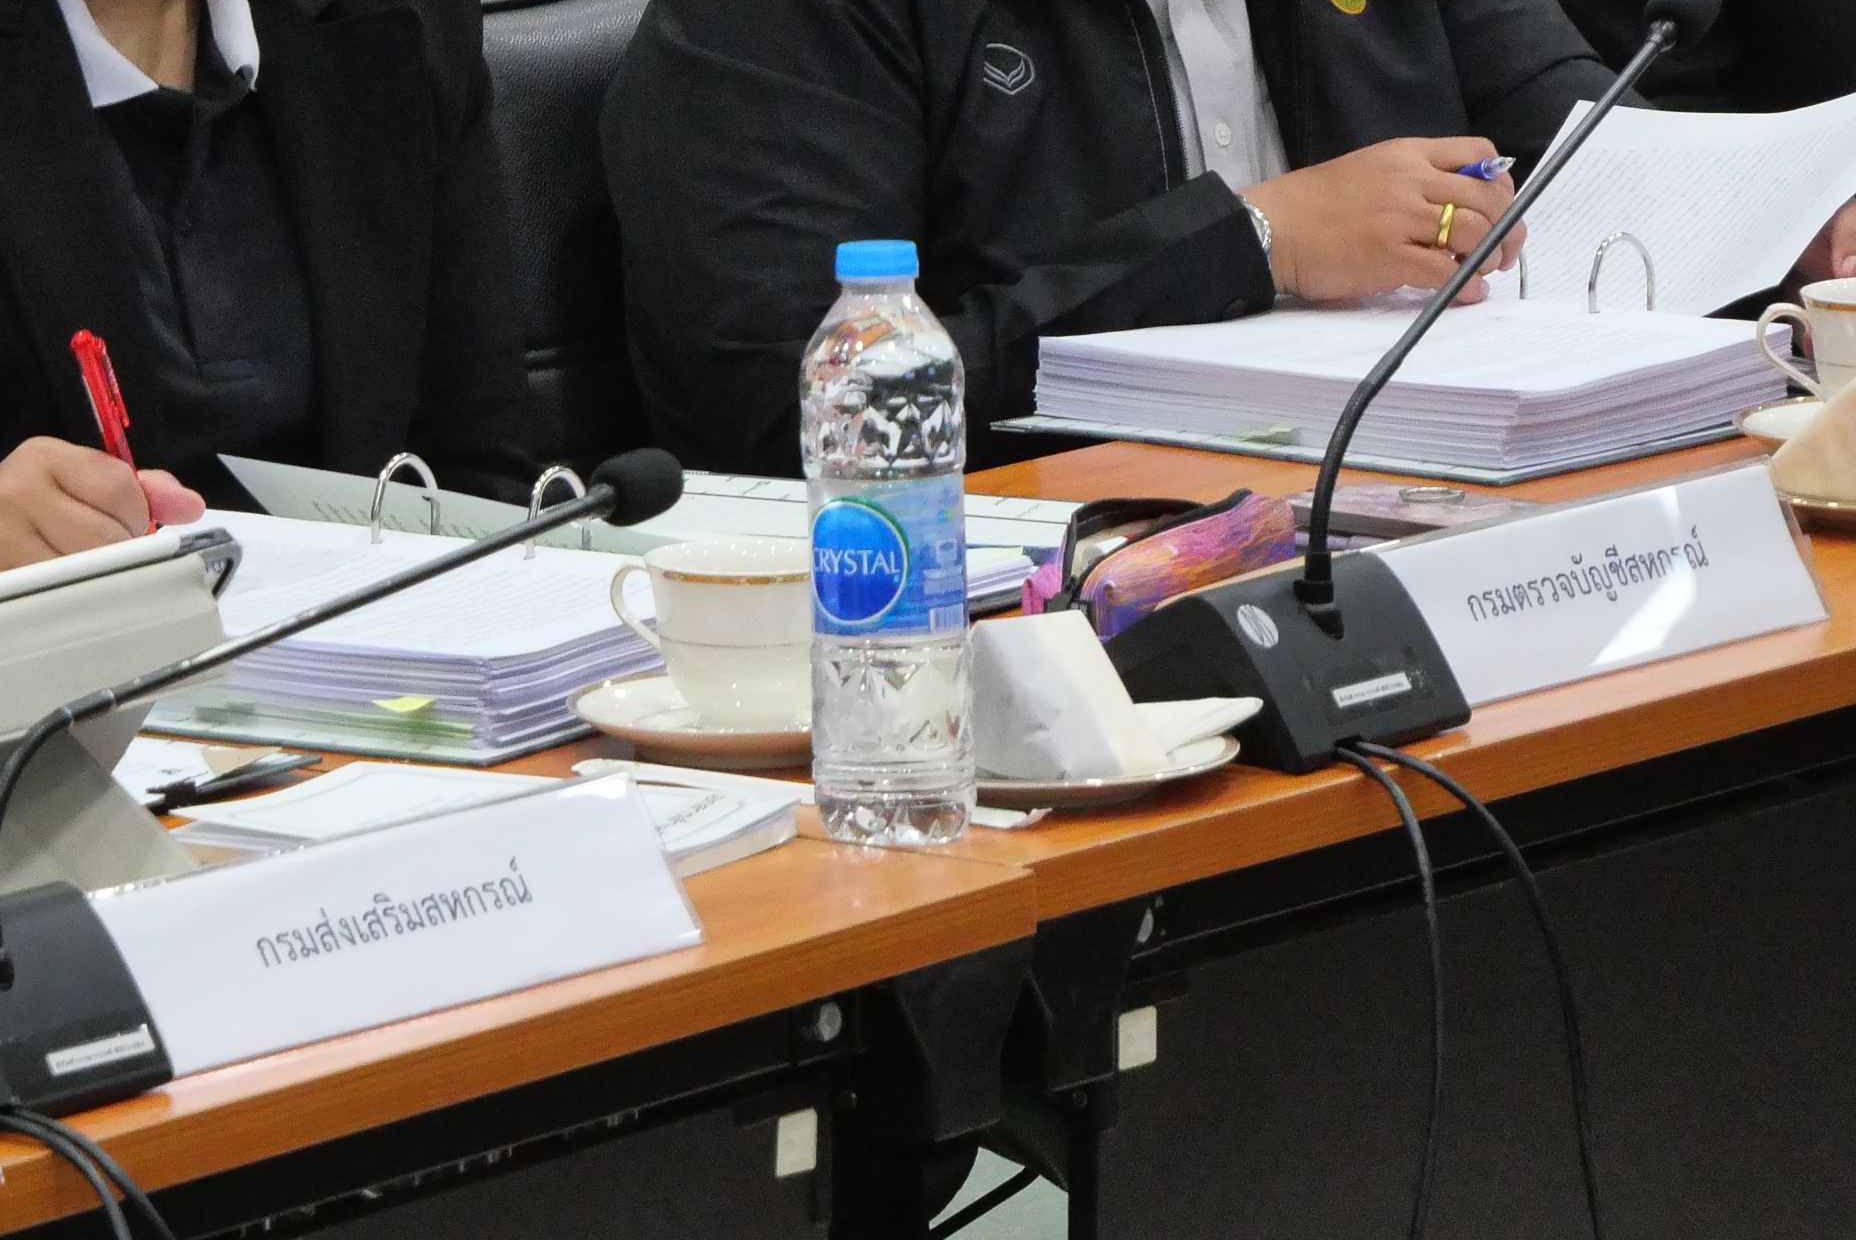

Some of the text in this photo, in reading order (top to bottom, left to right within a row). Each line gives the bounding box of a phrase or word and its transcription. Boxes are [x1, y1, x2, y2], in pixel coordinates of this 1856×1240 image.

[255, 855, 534, 968] กรมส่งเสริมสหกรณ์
